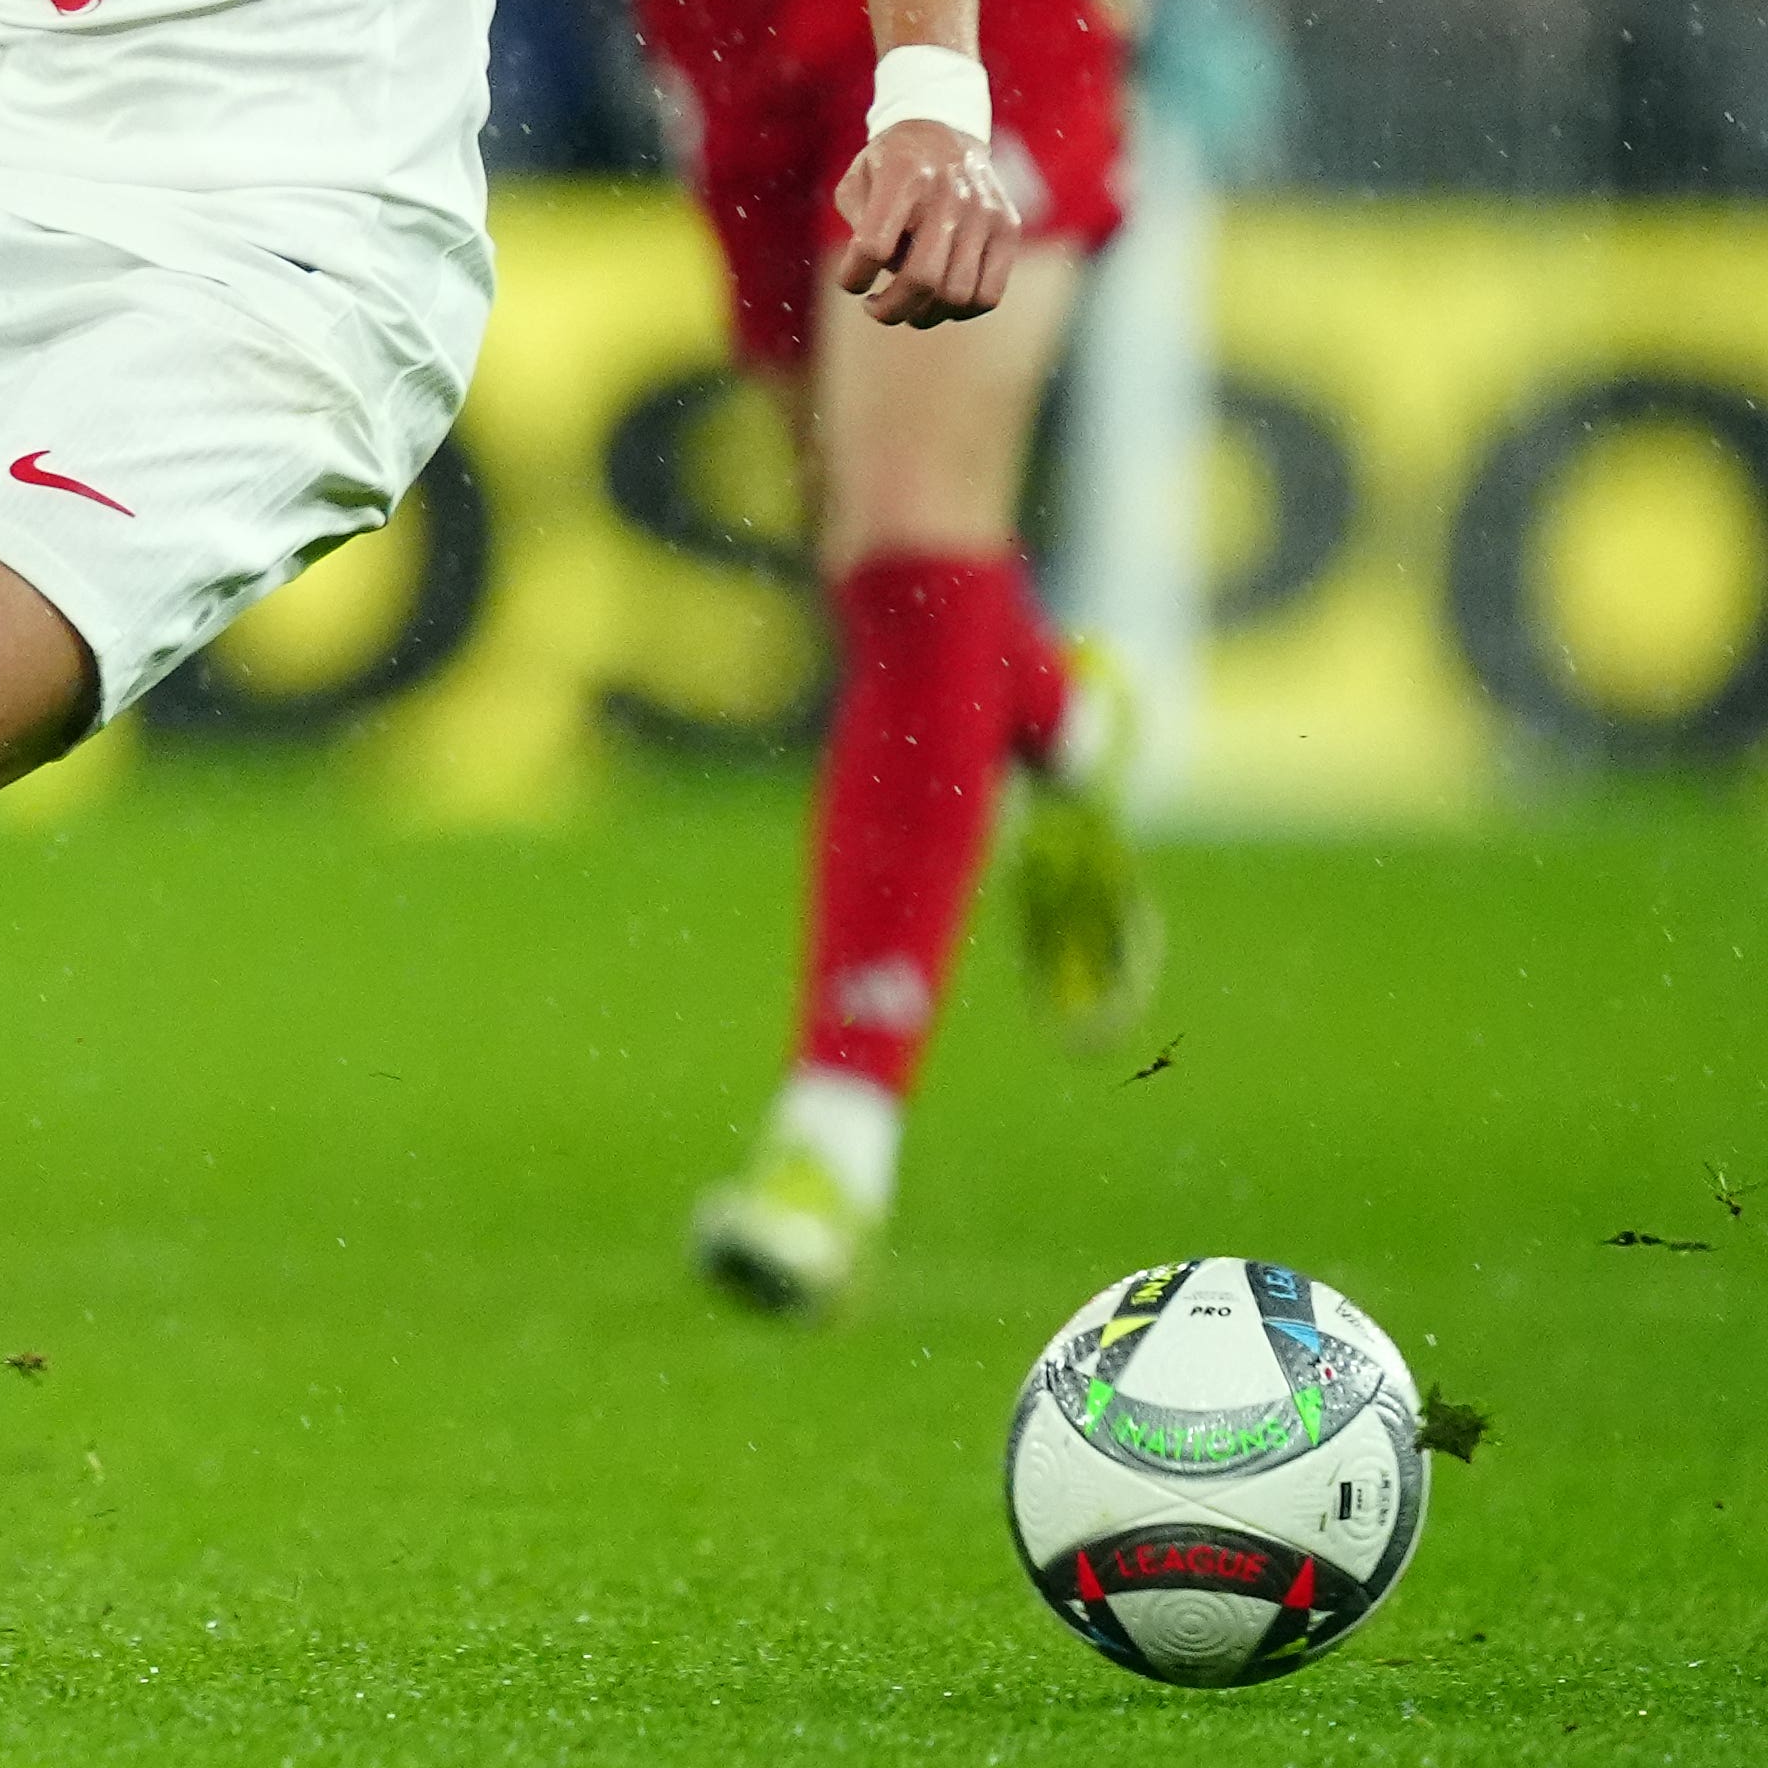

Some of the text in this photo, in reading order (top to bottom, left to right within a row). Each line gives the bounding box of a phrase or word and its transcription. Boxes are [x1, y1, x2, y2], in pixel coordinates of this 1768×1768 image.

[1190, 1306, 1232, 1317] PRO
[1112, 1411, 1290, 1462] NATIONS
[1115, 1544, 1268, 1582] LEAGUE
